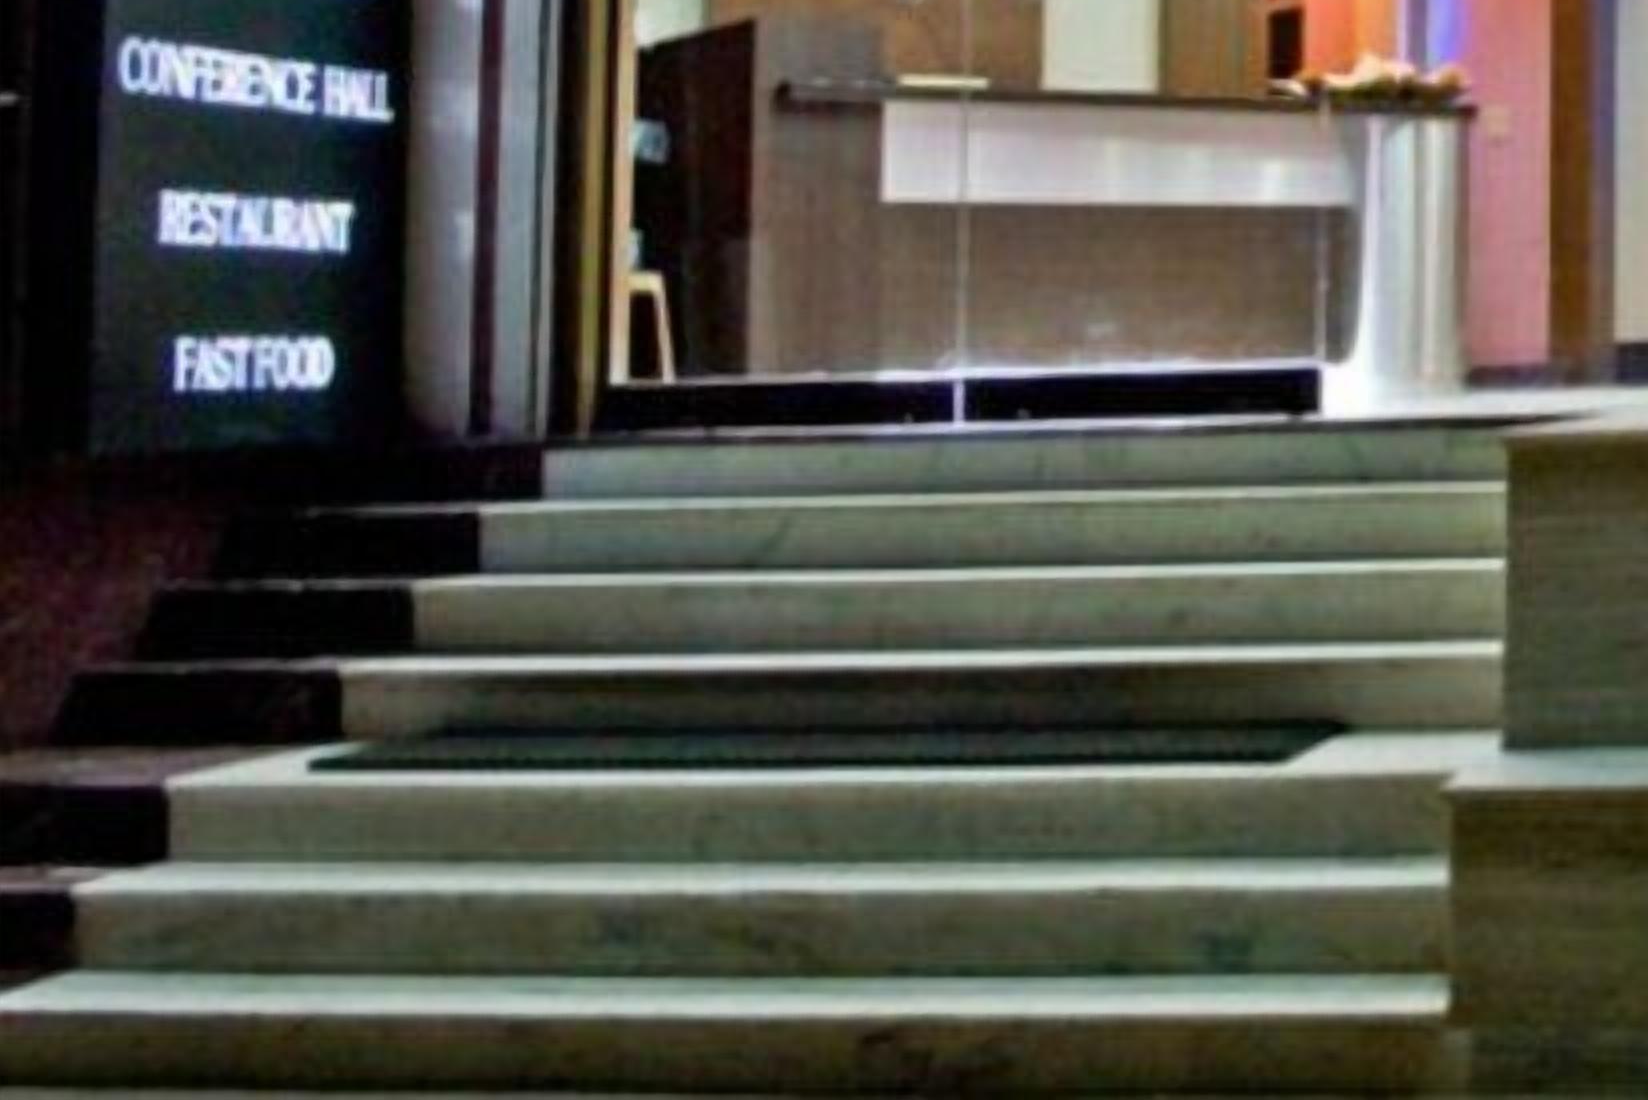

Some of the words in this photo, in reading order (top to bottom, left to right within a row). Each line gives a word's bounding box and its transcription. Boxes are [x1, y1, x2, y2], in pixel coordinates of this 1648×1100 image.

[117, 36, 316, 115] CONFERENCE
[322, 64, 393, 122] HALL
[157, 189, 354, 253] RESTAURANT
[173, 336, 252, 391] FAST
[252, 336, 335, 390] FOOD
